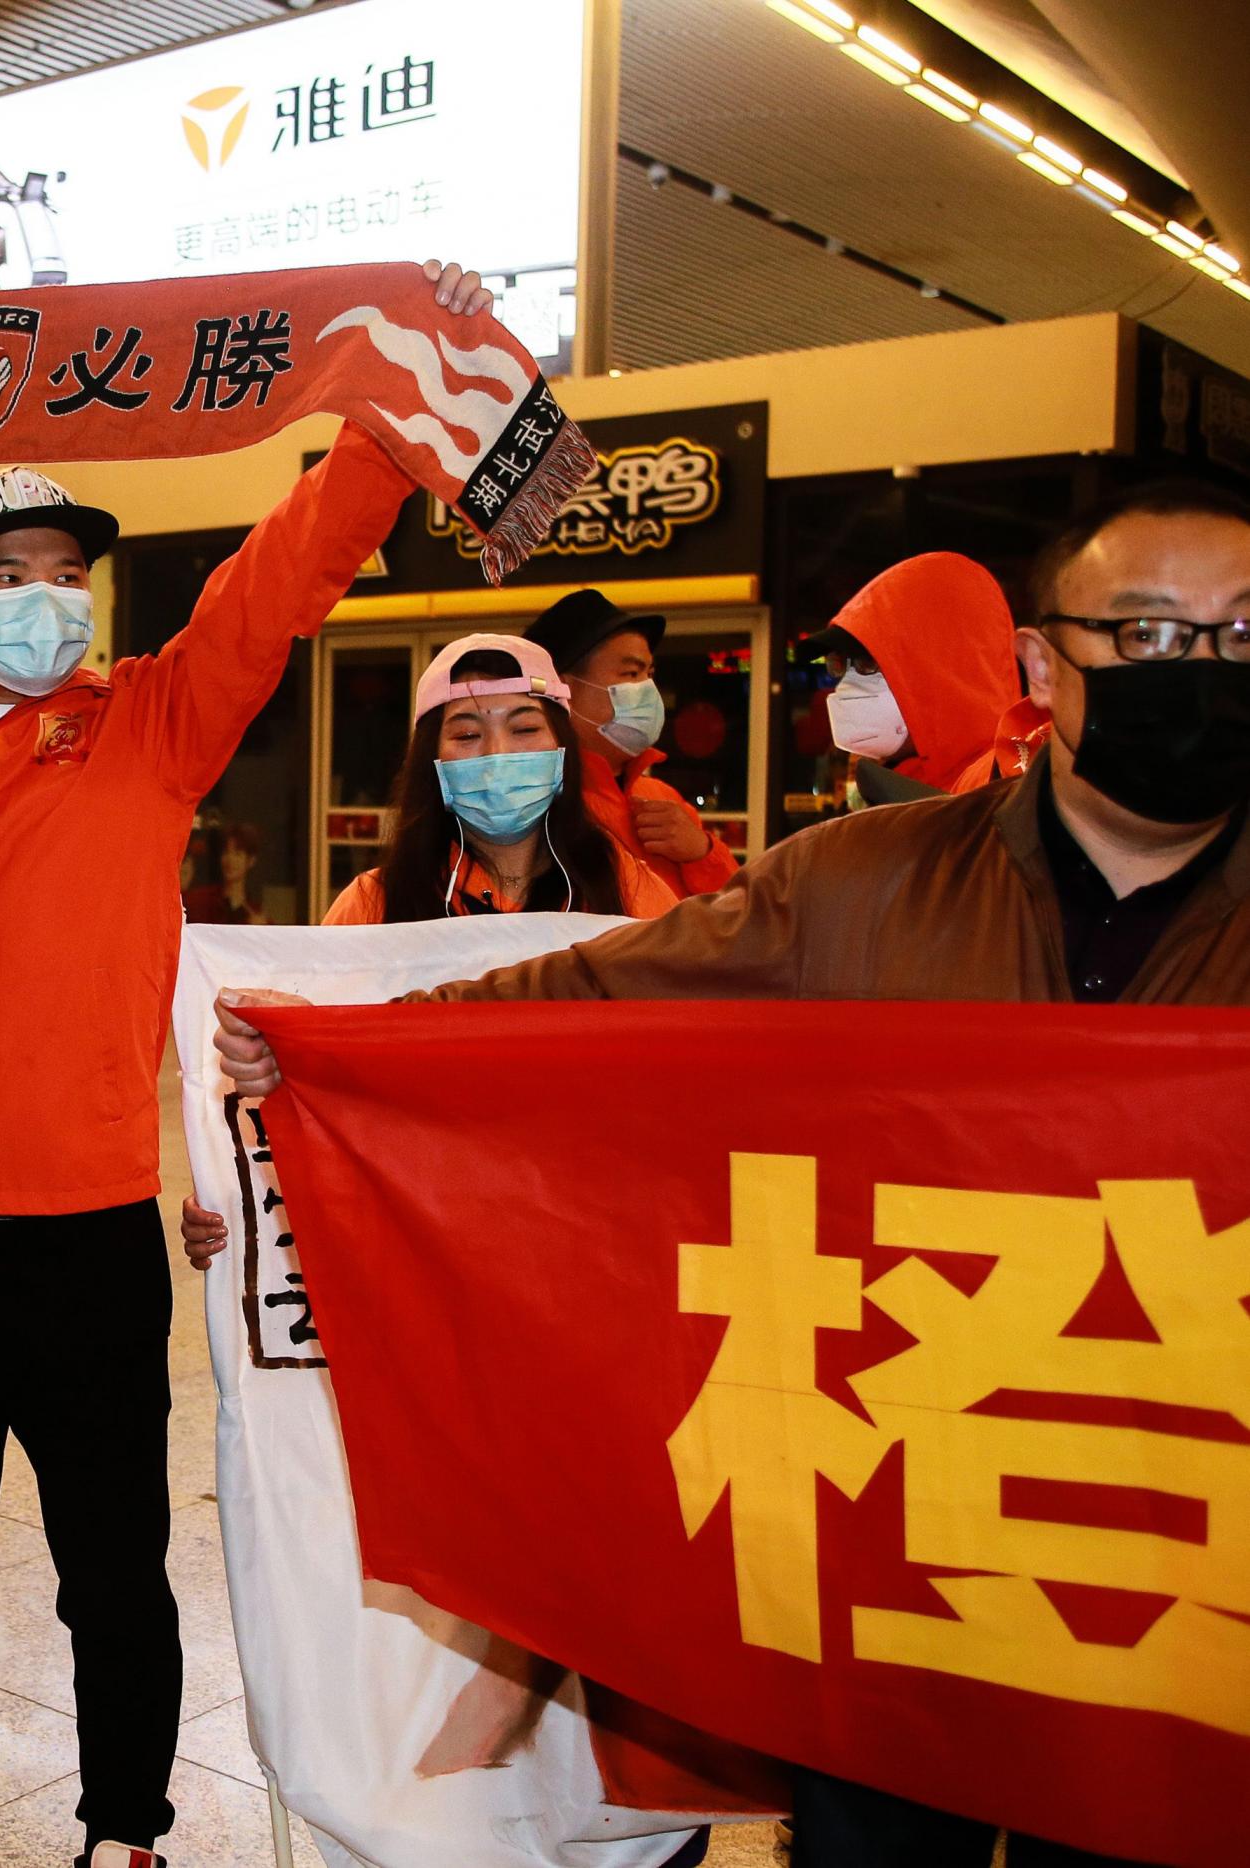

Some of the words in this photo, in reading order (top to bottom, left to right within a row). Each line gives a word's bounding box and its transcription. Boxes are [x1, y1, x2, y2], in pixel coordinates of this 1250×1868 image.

[270, 55, 437, 153] 雅迪
[174, 180, 443, 267] 更高端的电动车
[44, 308, 294, 417] 必勝
[665, 1151, 1250, 1738] 橙
